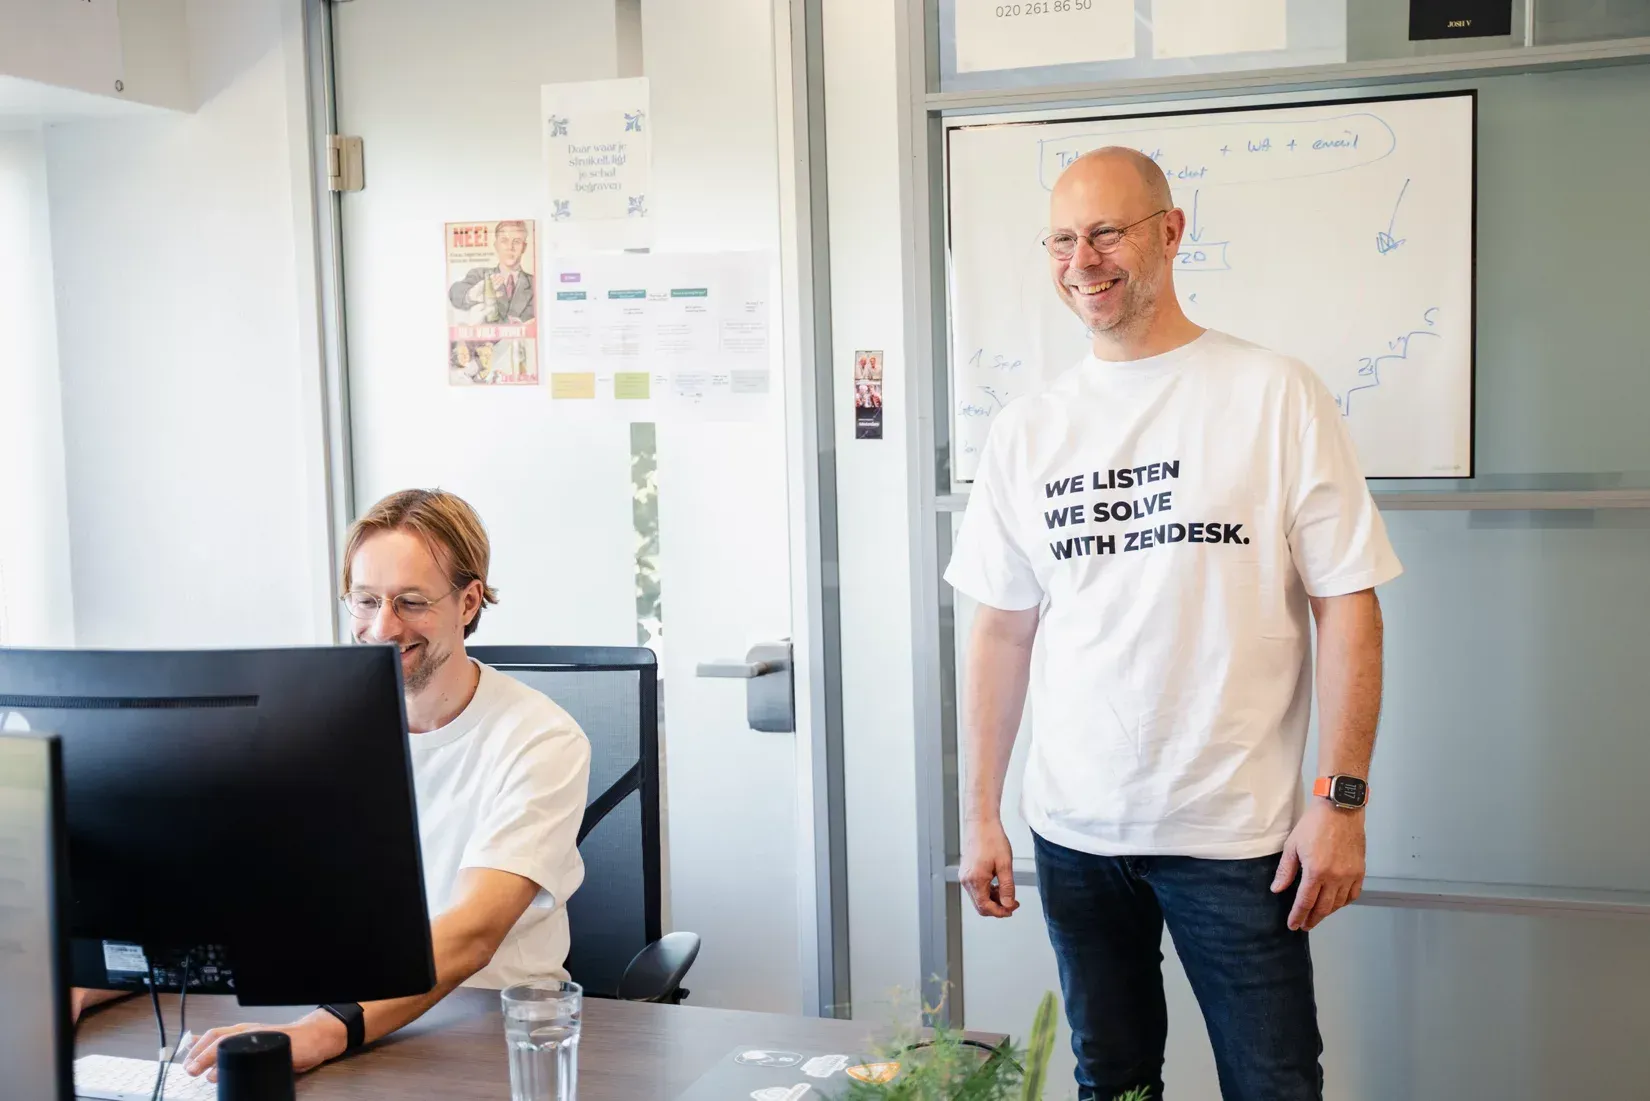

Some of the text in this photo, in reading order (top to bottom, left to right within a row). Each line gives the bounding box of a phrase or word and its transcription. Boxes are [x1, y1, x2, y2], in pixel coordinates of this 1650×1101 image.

[996, 0, 1092, 17] 020 261 86 50
[1447, 20, 1465, 28] JOSH
[568, 142, 627, 154] Daar waar je
[1312, 130, 1358, 150] email
[579, 170, 588, 181] je
[574, 182, 622, 193] begraven
[453, 226, 488, 247] NEE!
[1045, 460, 1180, 498] WE LISTEN
[1044, 491, 1172, 529] WE SOLVE
[1050, 522, 1250, 560] WITH ZENDESK.
